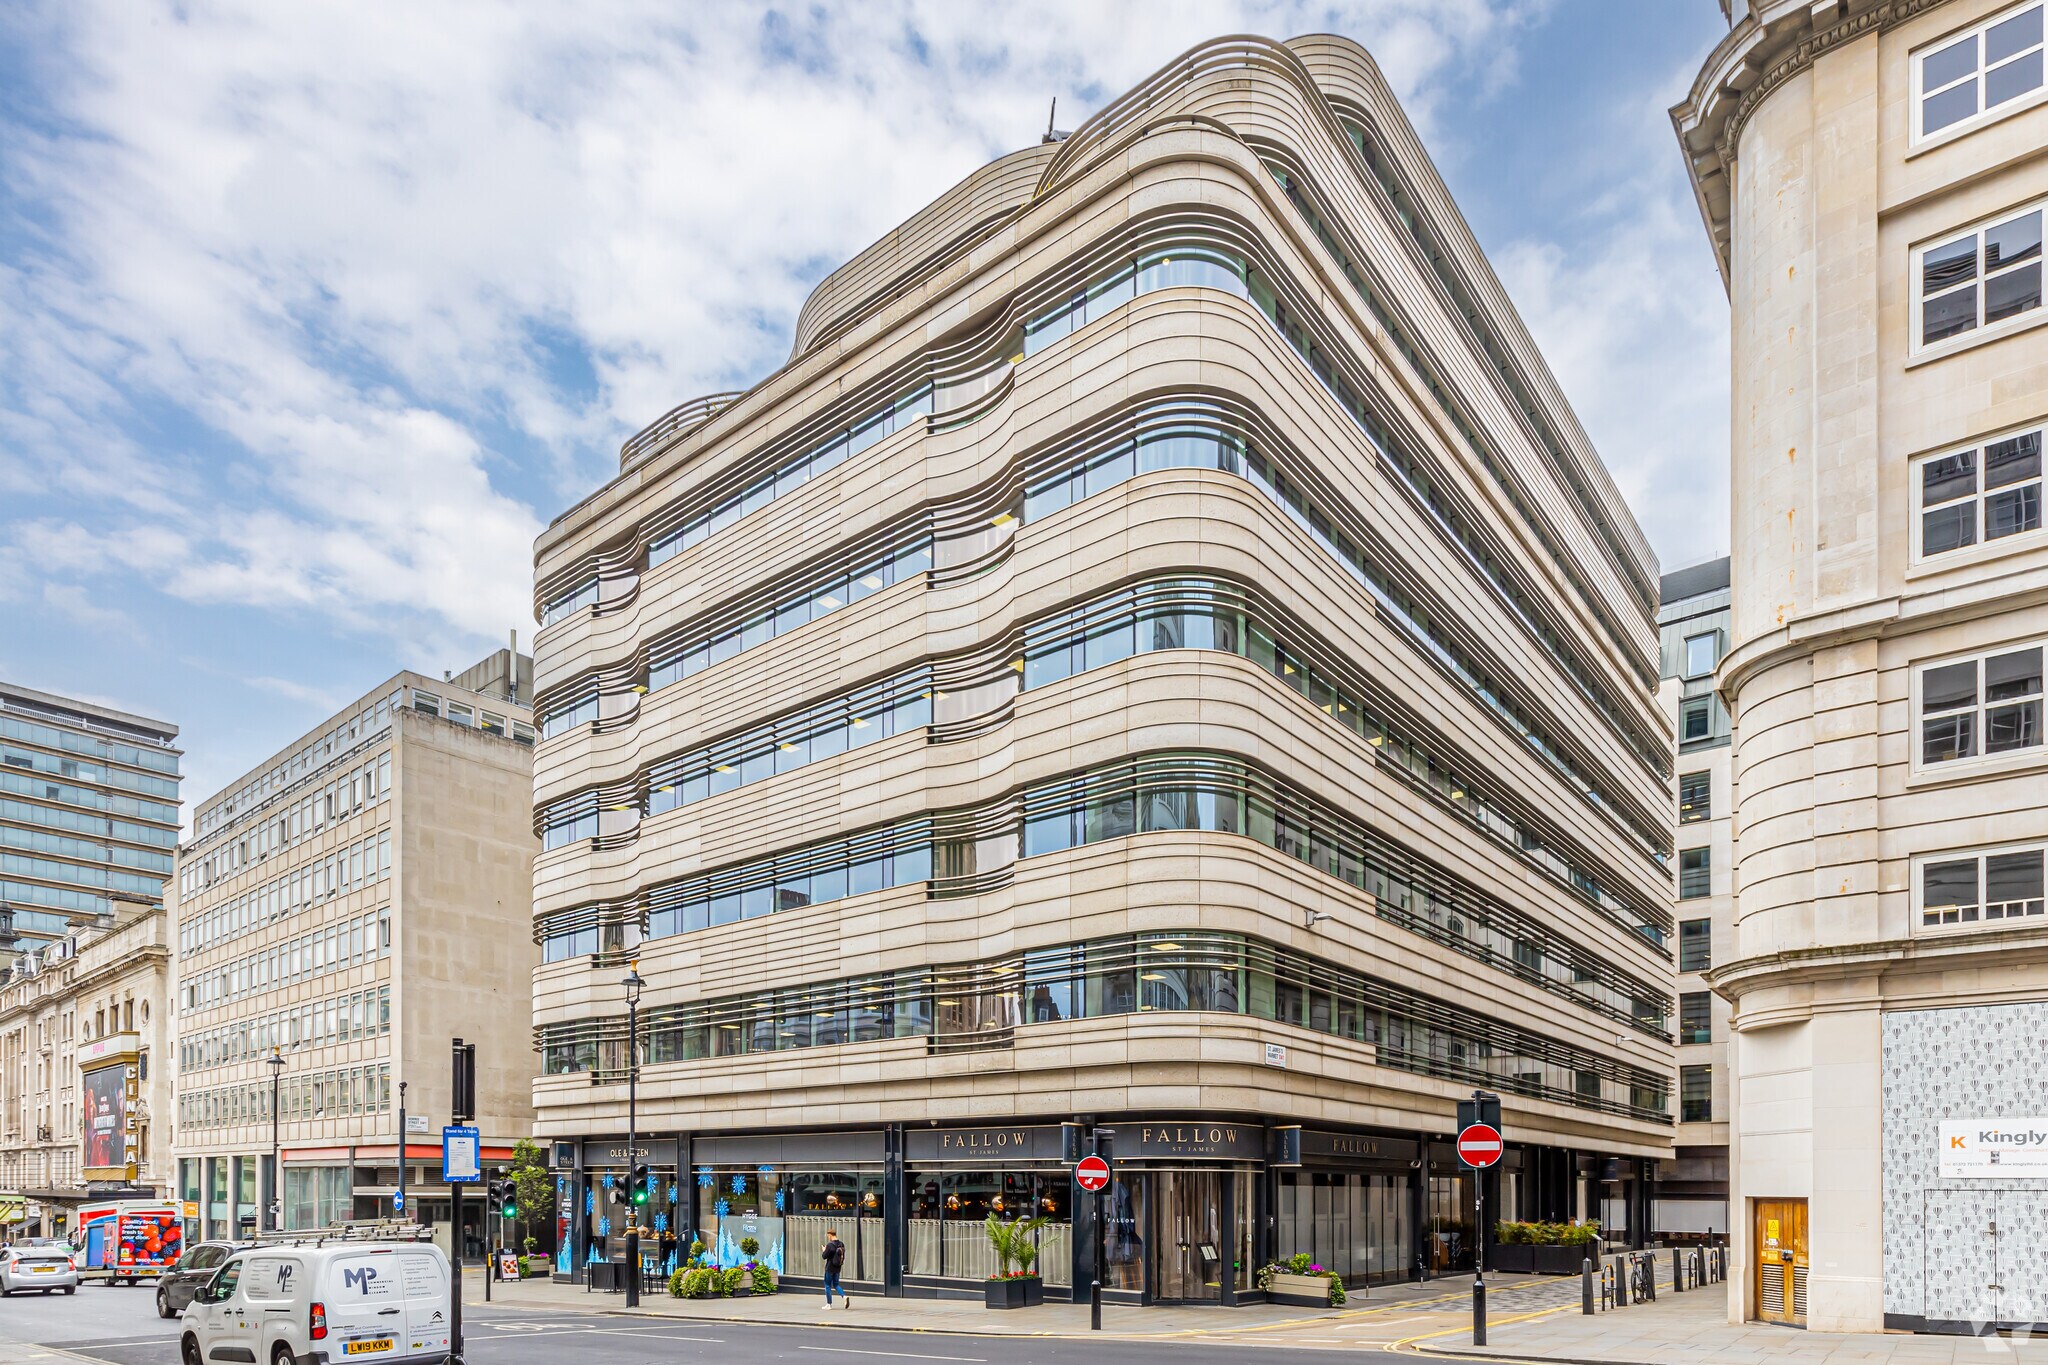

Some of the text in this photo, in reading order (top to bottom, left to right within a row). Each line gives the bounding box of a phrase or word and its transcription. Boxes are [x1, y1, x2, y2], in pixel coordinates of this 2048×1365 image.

[126, 1066, 137, 1163] CINEMA
[943, 1132, 1026, 1147] FALLOW
[1142, 1128, 1237, 1144] FALLOW
[1951, 1136, 1966, 1149] K
[1979, 1130, 2047, 1146] Kingly
[610, 1149, 622, 1158] OLE
[623, 1149, 628, 1157] &
[1333, 1139, 1378, 1154] FALLOW
[350, 1340, 390, 1352] LW19 KKM
